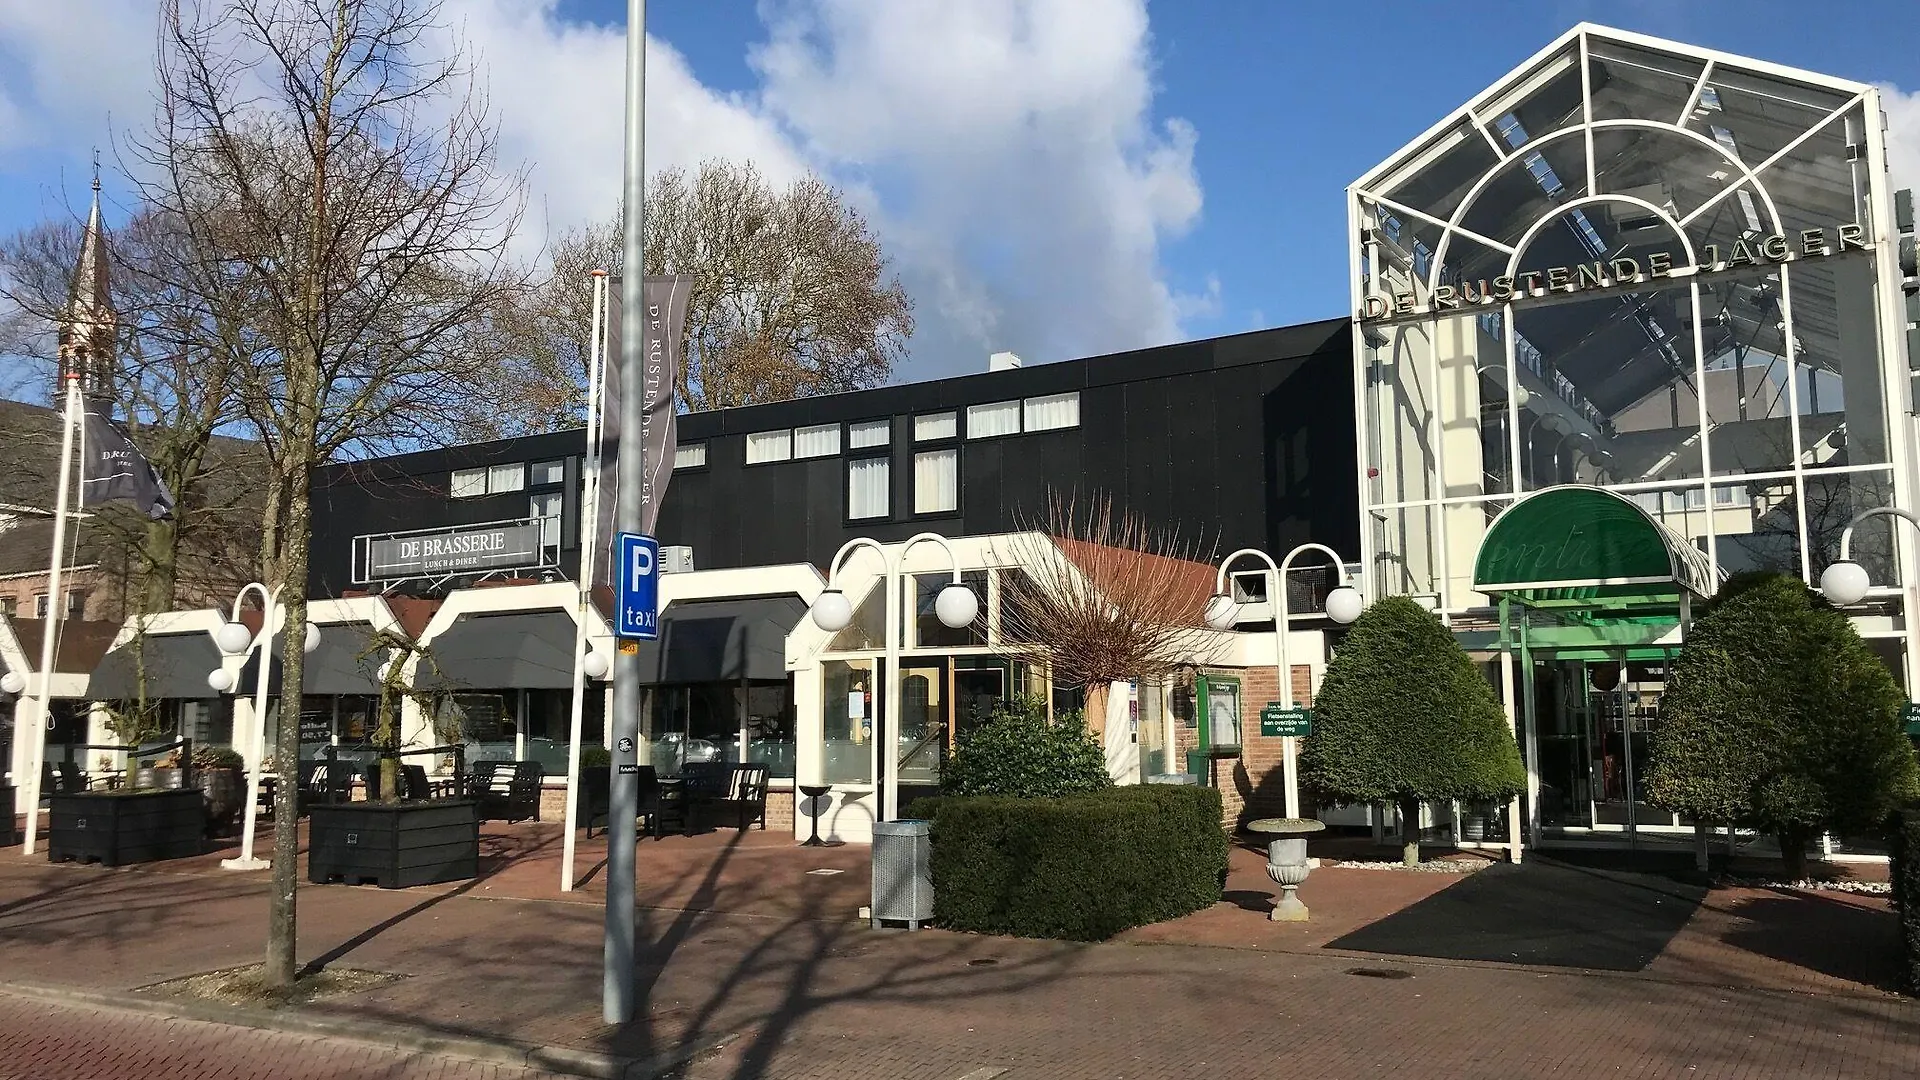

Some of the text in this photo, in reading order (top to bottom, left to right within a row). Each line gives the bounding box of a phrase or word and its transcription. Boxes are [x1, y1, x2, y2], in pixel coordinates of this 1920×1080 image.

[1364, 292, 1414, 319] DE
[1433, 251, 1672, 309] RUSTENDE
[649, 304, 661, 331] DE
[642, 338, 662, 438] RUSTENDE
[400, 533, 505, 559] DE BRASSERIE
[455, 557, 477, 565] DINER
[632, 545, 653, 592] P
[626, 606, 655, 628] taxi
